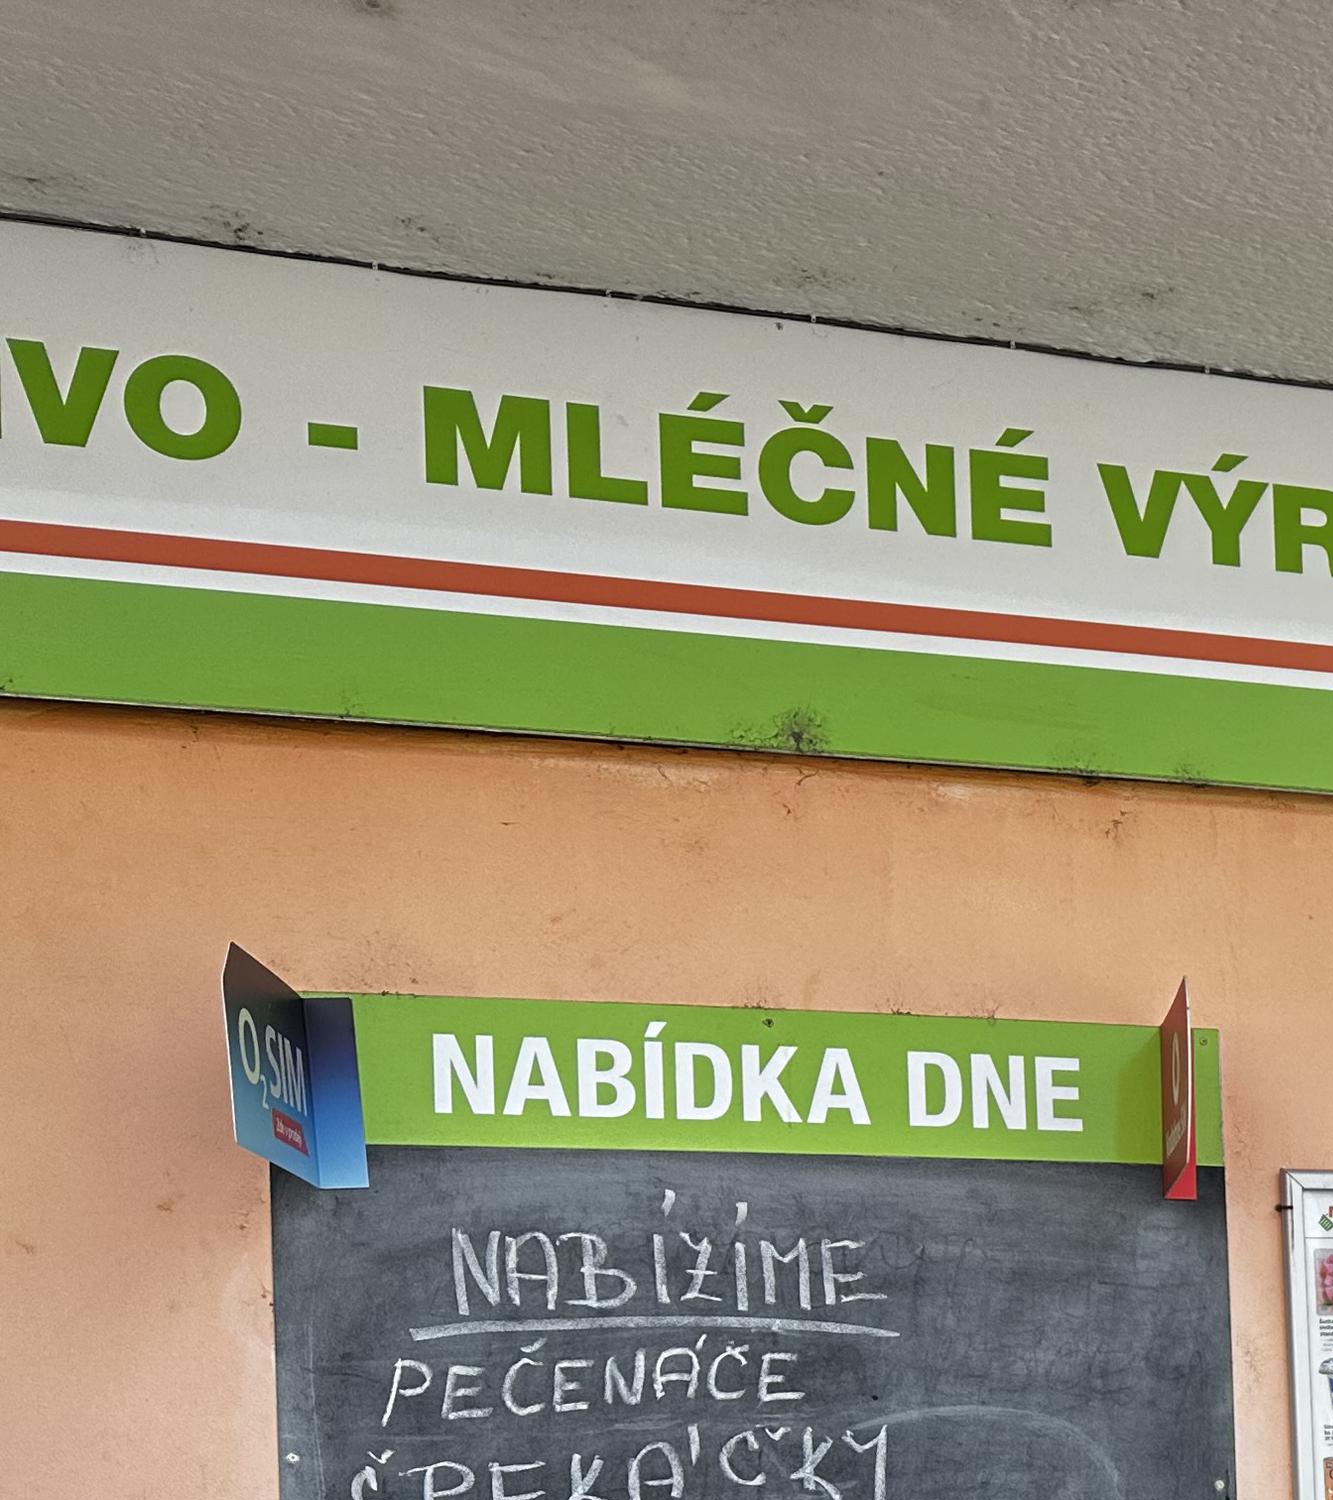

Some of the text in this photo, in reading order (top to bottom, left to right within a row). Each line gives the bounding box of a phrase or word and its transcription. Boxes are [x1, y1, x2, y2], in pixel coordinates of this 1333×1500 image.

[0, 338, 242, 460] VO
[424, 388, 1054, 549] MLÉČNÉ
[265, 1024, 308, 1118] SIM
[432, 1022, 873, 1126] NABÍDKA
[907, 1051, 1085, 1132] DNE
[452, 1189, 888, 1317] NABÍZÍME
[382, 1333, 806, 1427] PEČENÁČE
